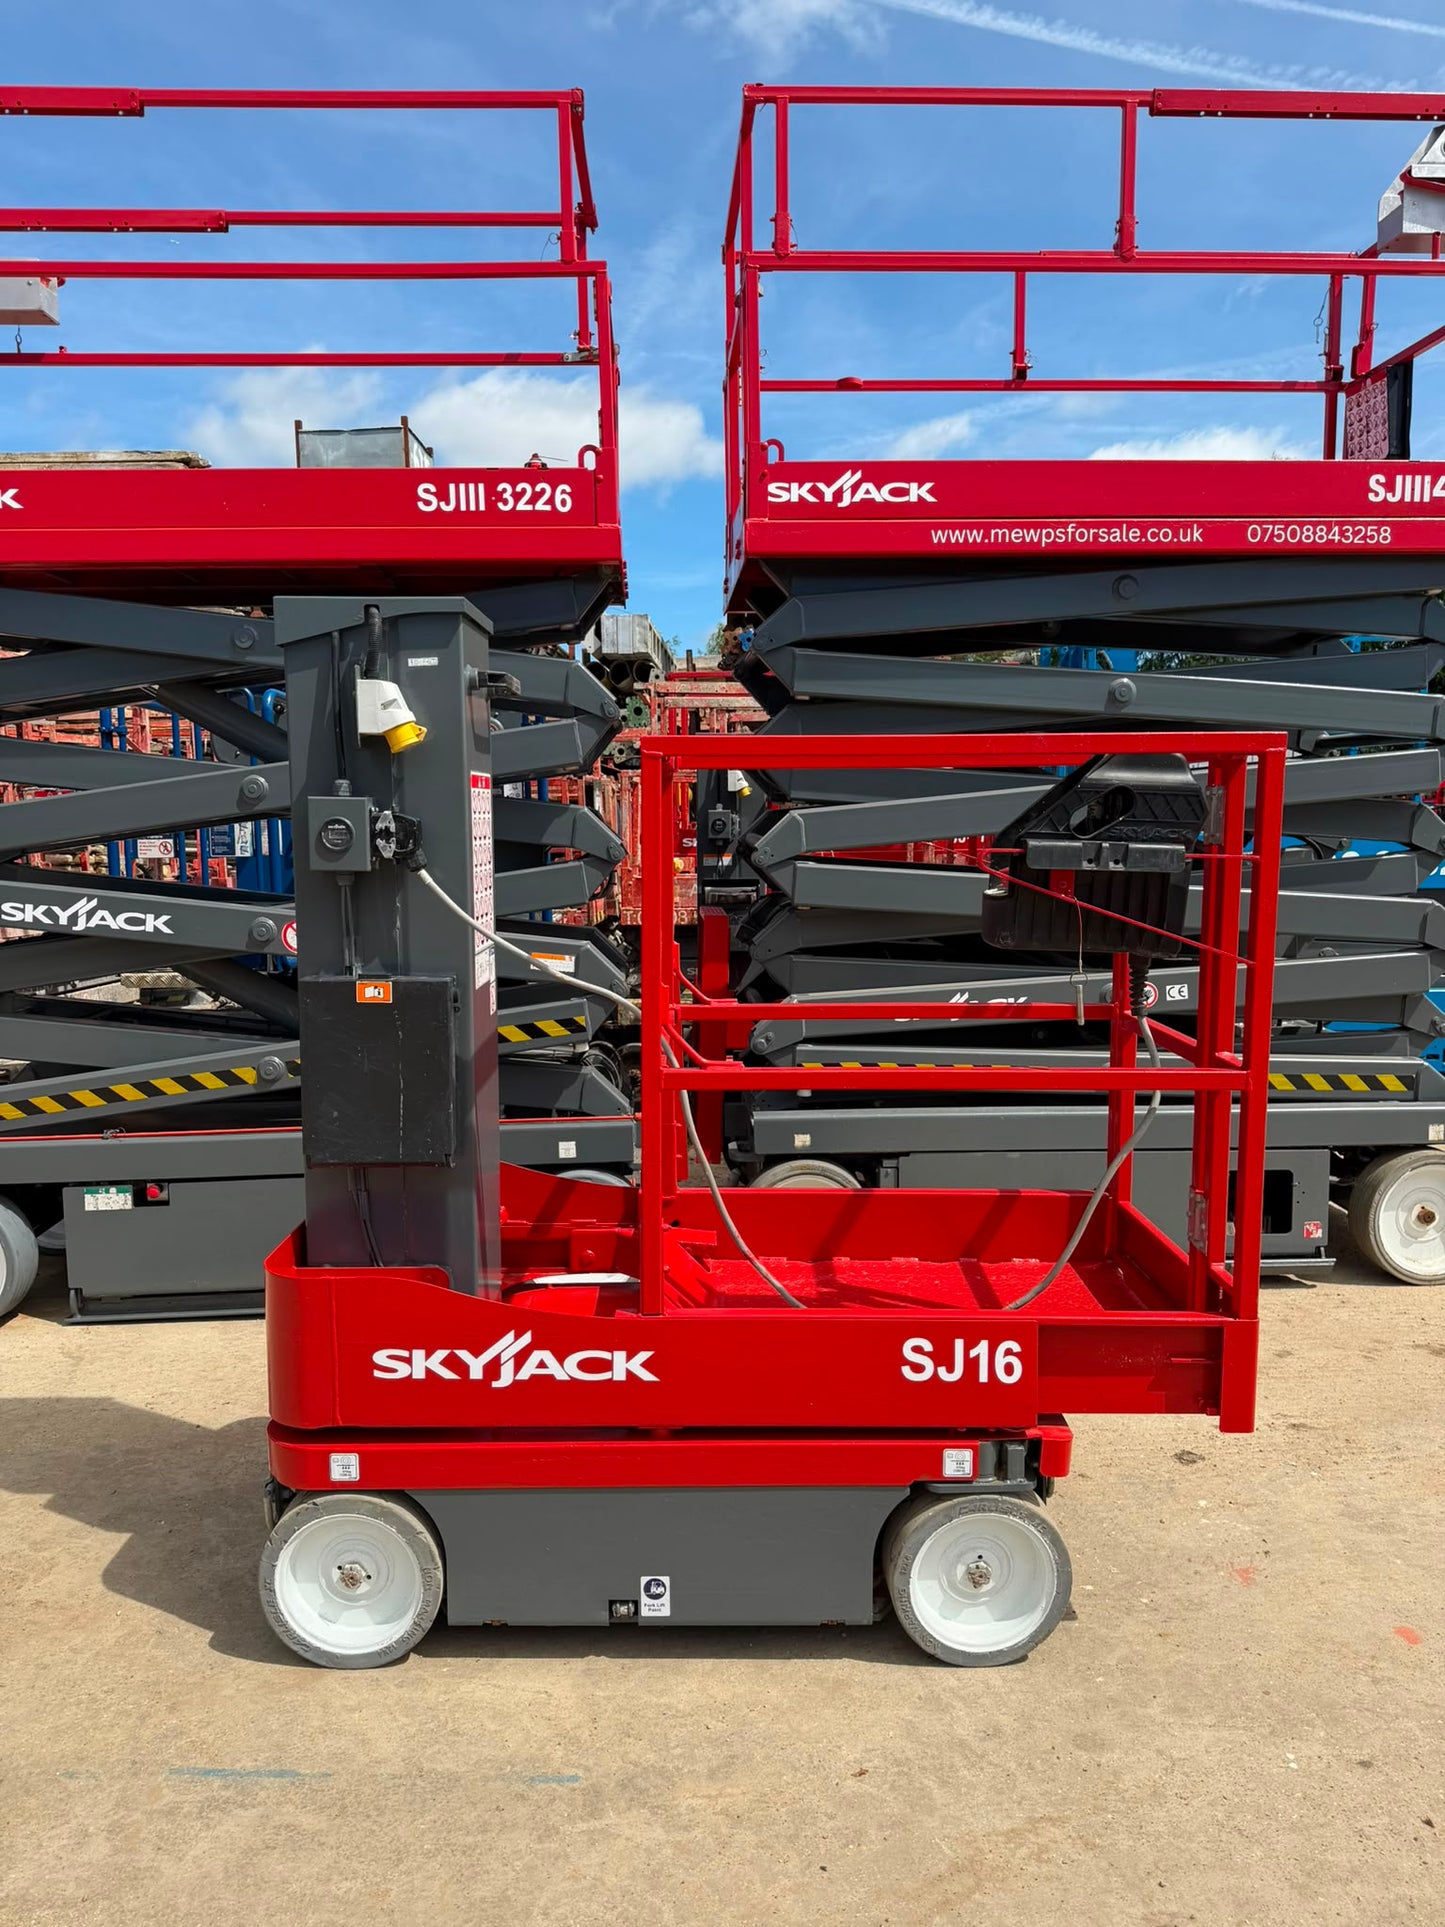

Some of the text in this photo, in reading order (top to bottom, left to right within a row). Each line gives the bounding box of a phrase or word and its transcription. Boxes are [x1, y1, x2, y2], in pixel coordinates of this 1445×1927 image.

[417, 482, 573, 513] SJIII 3226
[768, 470, 937, 507] SKYJACK
[931, 524, 1392, 548] www.mewpsforsale.co.uk 07508843258
[1, 896, 175, 934] SKYJACK
[372, 1330, 659, 1387] SKYJACK
[901, 1337, 1023, 1384] SJ16
